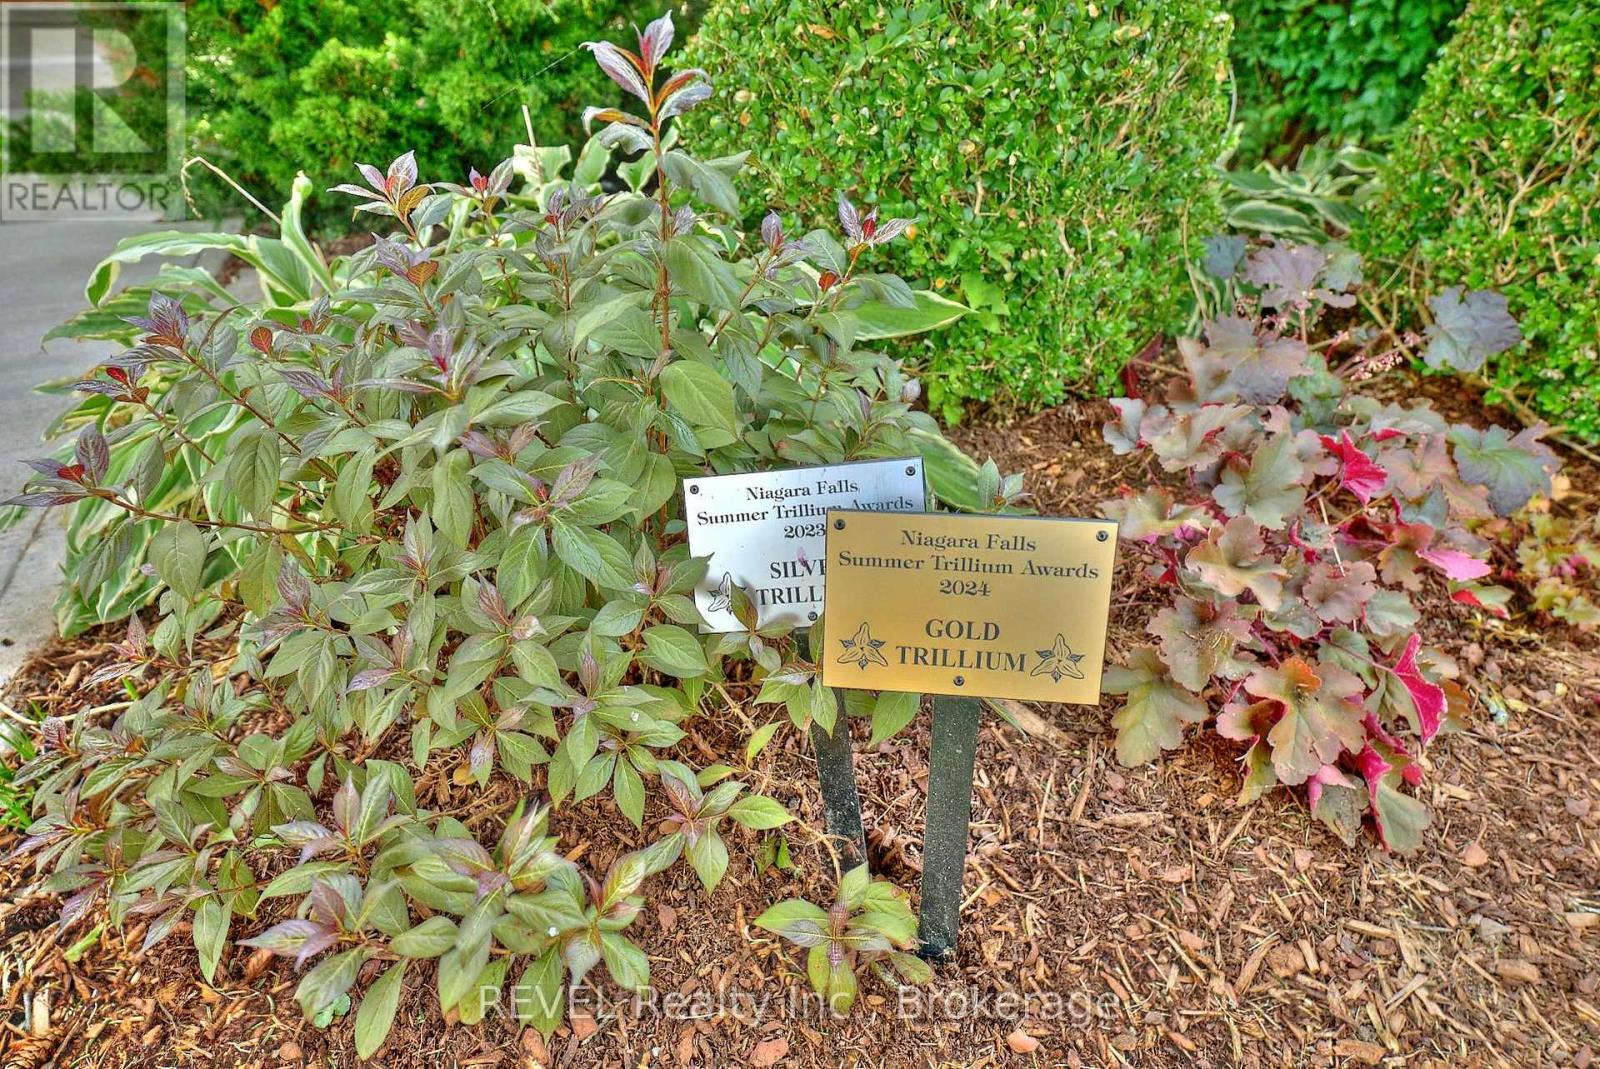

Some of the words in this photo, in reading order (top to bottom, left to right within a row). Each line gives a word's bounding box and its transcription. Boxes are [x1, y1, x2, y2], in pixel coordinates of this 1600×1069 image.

[745, 485, 811, 502] Niagara
[816, 479, 858, 495] Falls
[696, 511, 769, 526] Summer
[773, 502, 842, 520] Trilliu
[850, 496, 914, 511] Awards
[784, 523, 826, 539] 2023
[901, 530, 978, 550] Niagara
[987, 534, 1036, 552] Falls
[838, 551, 925, 571] Summer
[931, 555, 1013, 575] Trillium
[1020, 560, 1099, 579] Awards
[756, 585, 826, 606] TRILL
[939, 579, 991, 597] 2024
[925, 618, 1001, 641] GOLD
[895, 646, 1027, 672] TRILLIUM
